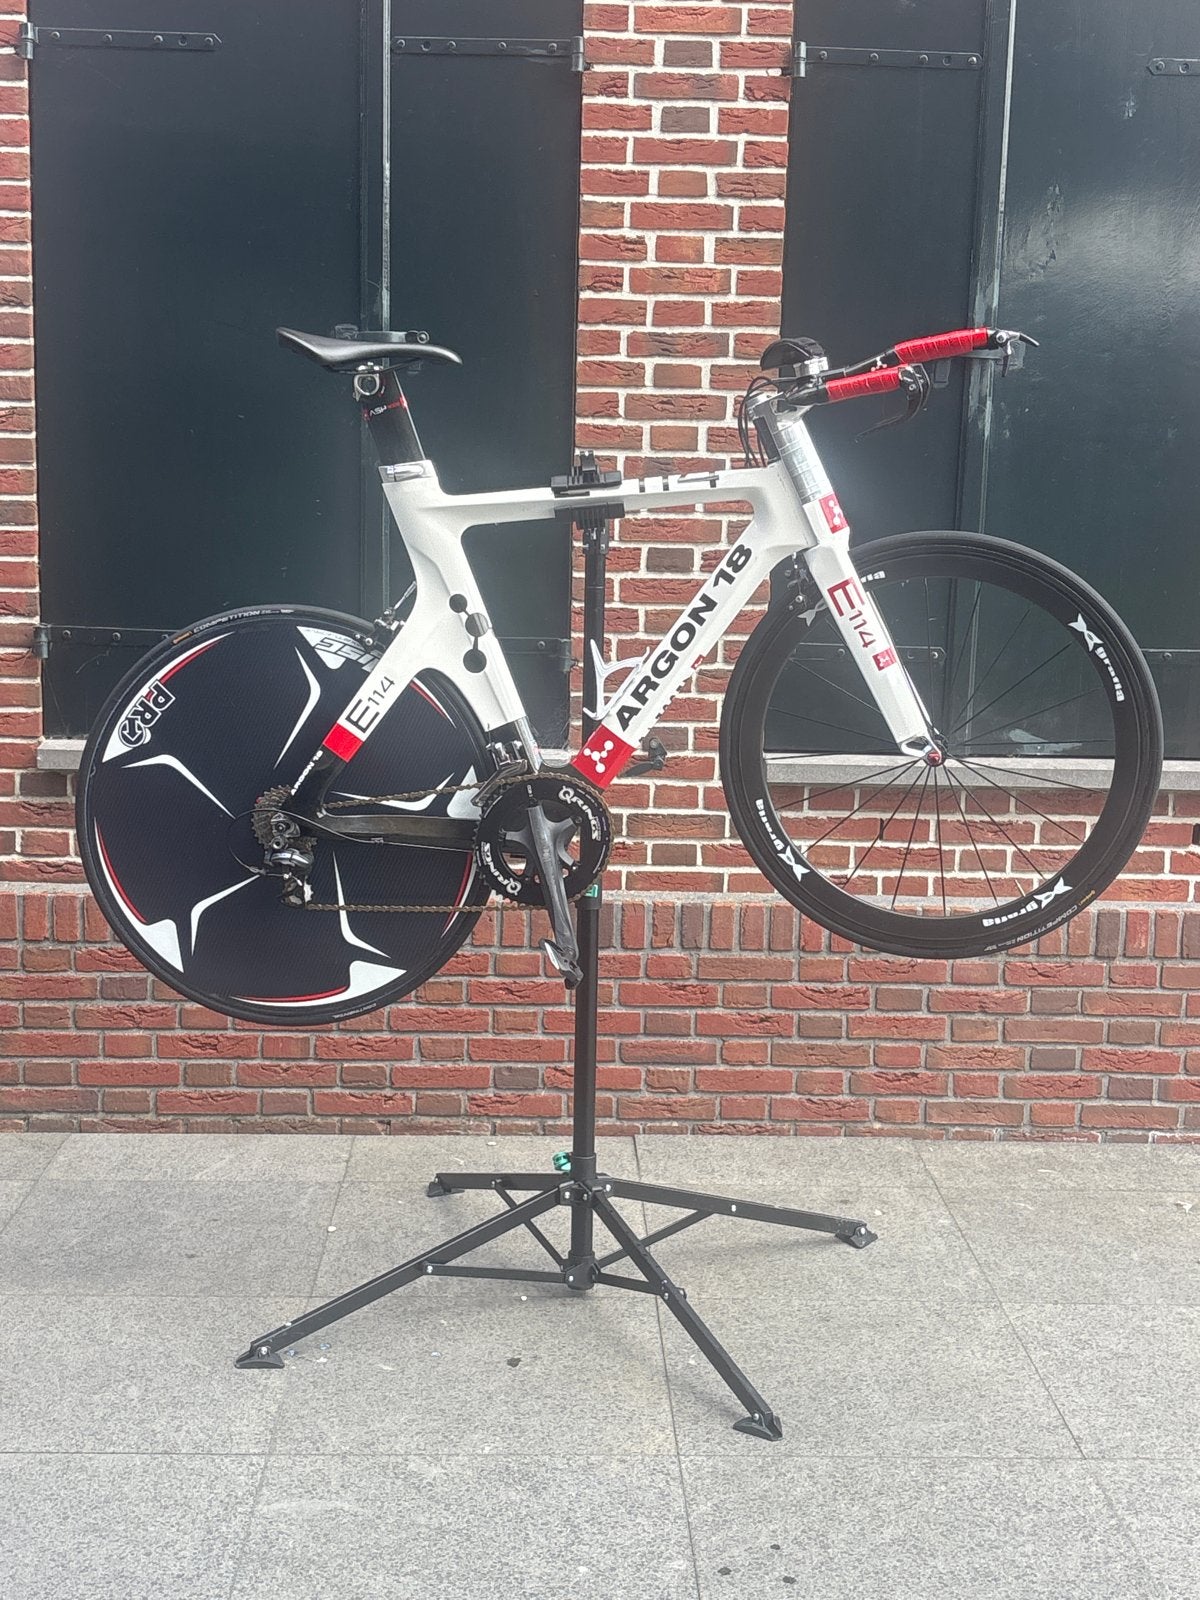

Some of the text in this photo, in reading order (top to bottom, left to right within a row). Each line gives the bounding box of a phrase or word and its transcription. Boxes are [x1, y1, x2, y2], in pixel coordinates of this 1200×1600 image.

[193, 610, 260, 633] COMPETITION
[616, 593, 718, 732] ARGON
[713, 544, 752, 587] 18
[827, 577, 877, 648] E114
[345, 676, 395, 733] E114
[1017, 905, 1078, 942] COMPETITION
